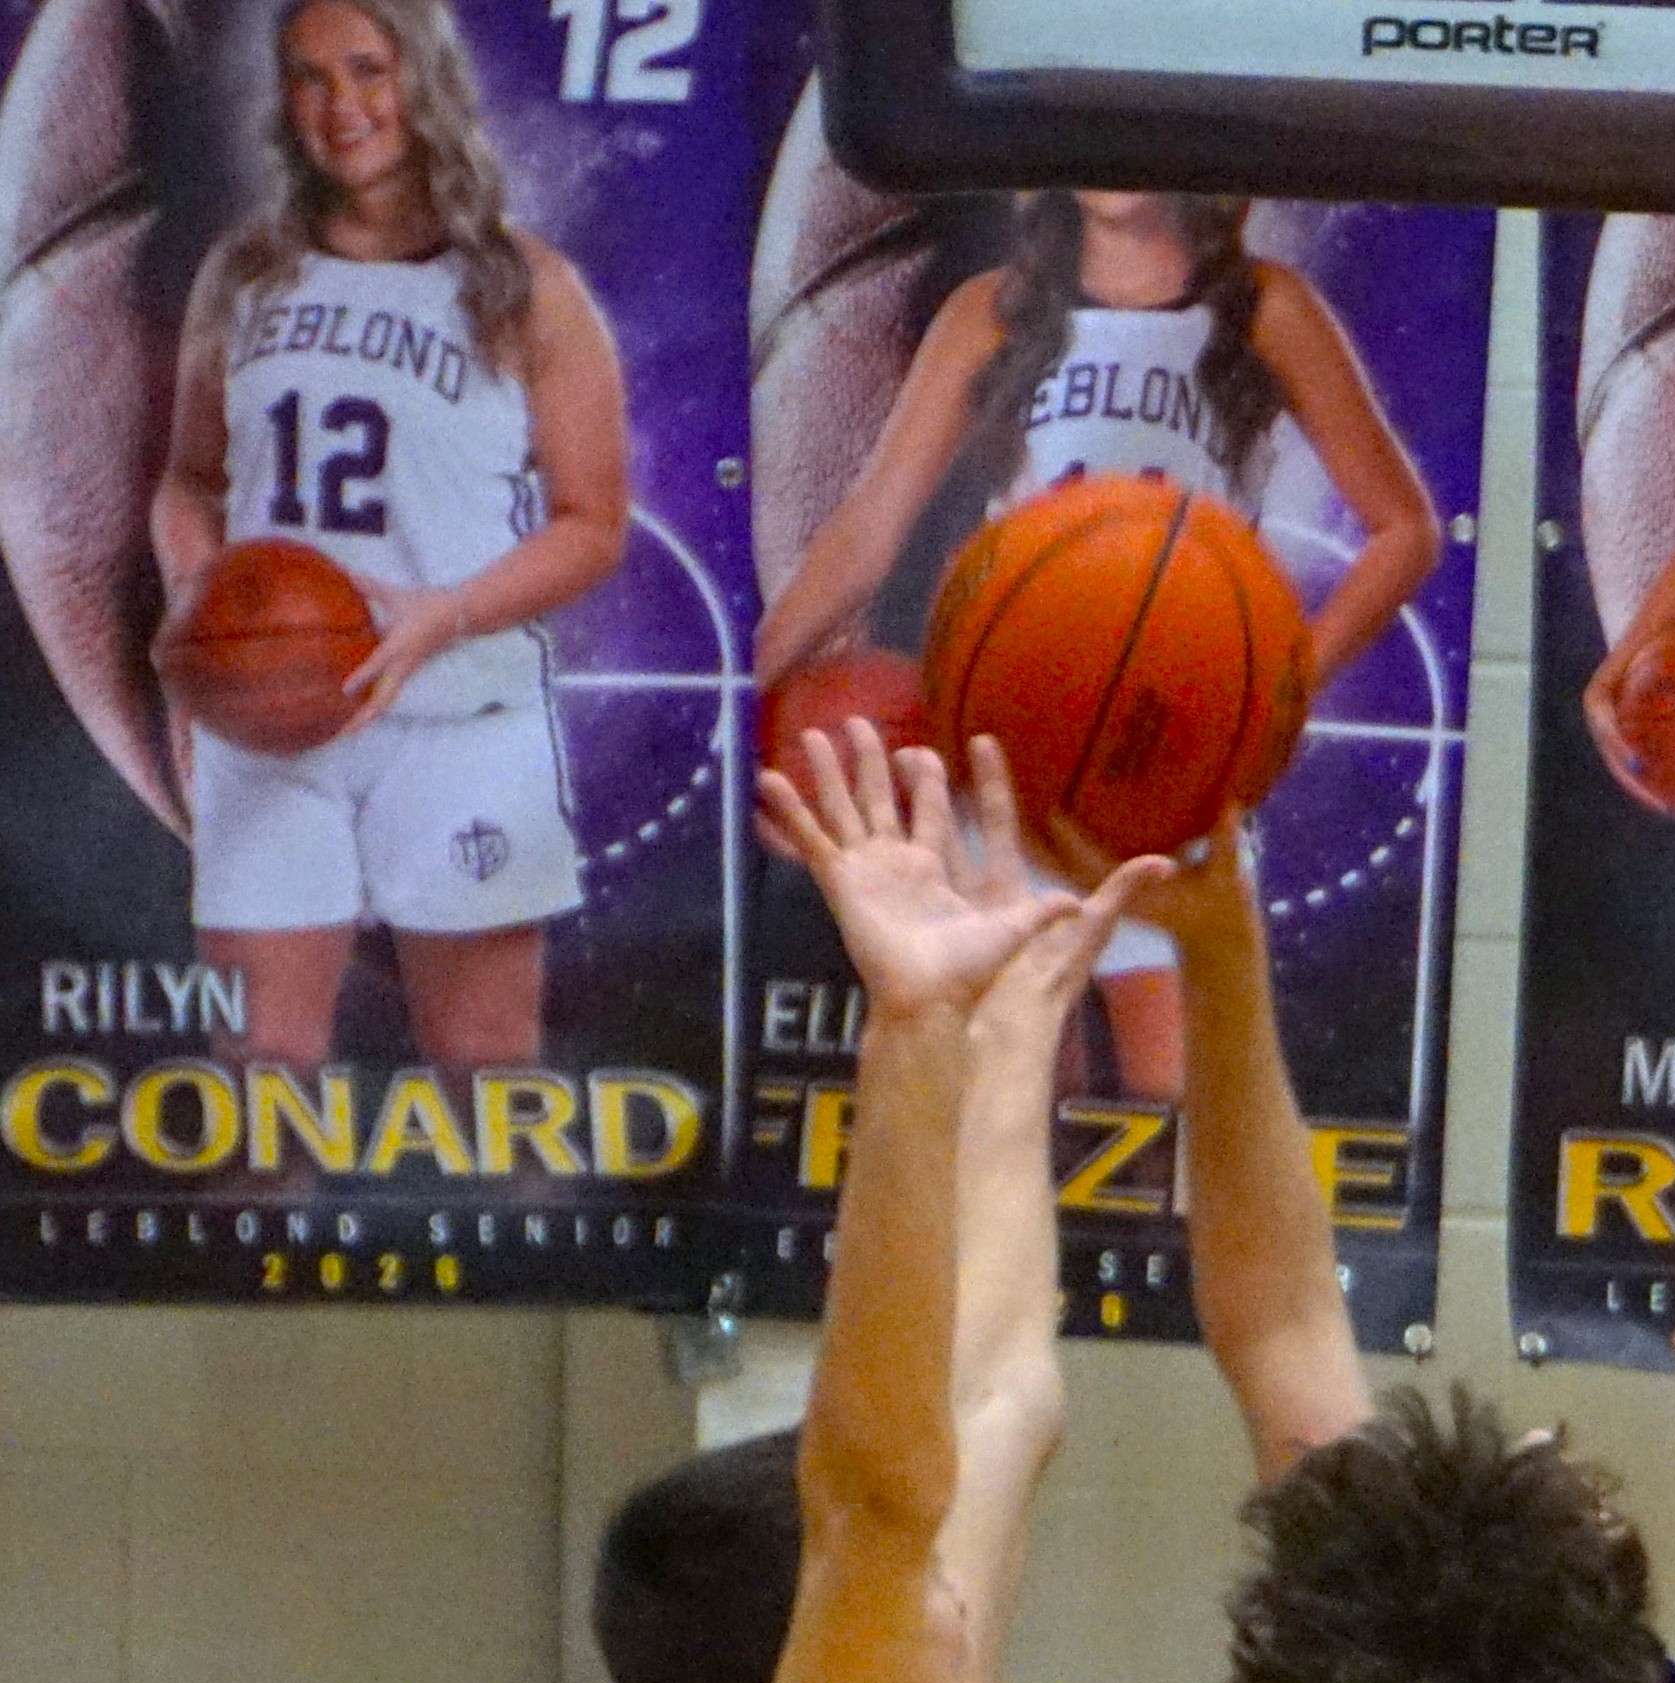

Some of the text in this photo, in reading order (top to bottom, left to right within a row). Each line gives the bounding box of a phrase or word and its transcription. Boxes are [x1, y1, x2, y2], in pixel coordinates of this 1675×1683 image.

[549, 0, 702, 102] 12
[232, 302, 466, 404] EBLOND
[265, 388, 390, 536] 12
[40, 960, 248, 1034] RILYN
[0, 1057, 700, 1178] CONARD
[40, 1210, 675, 1248] LEBLOND SENIOR
